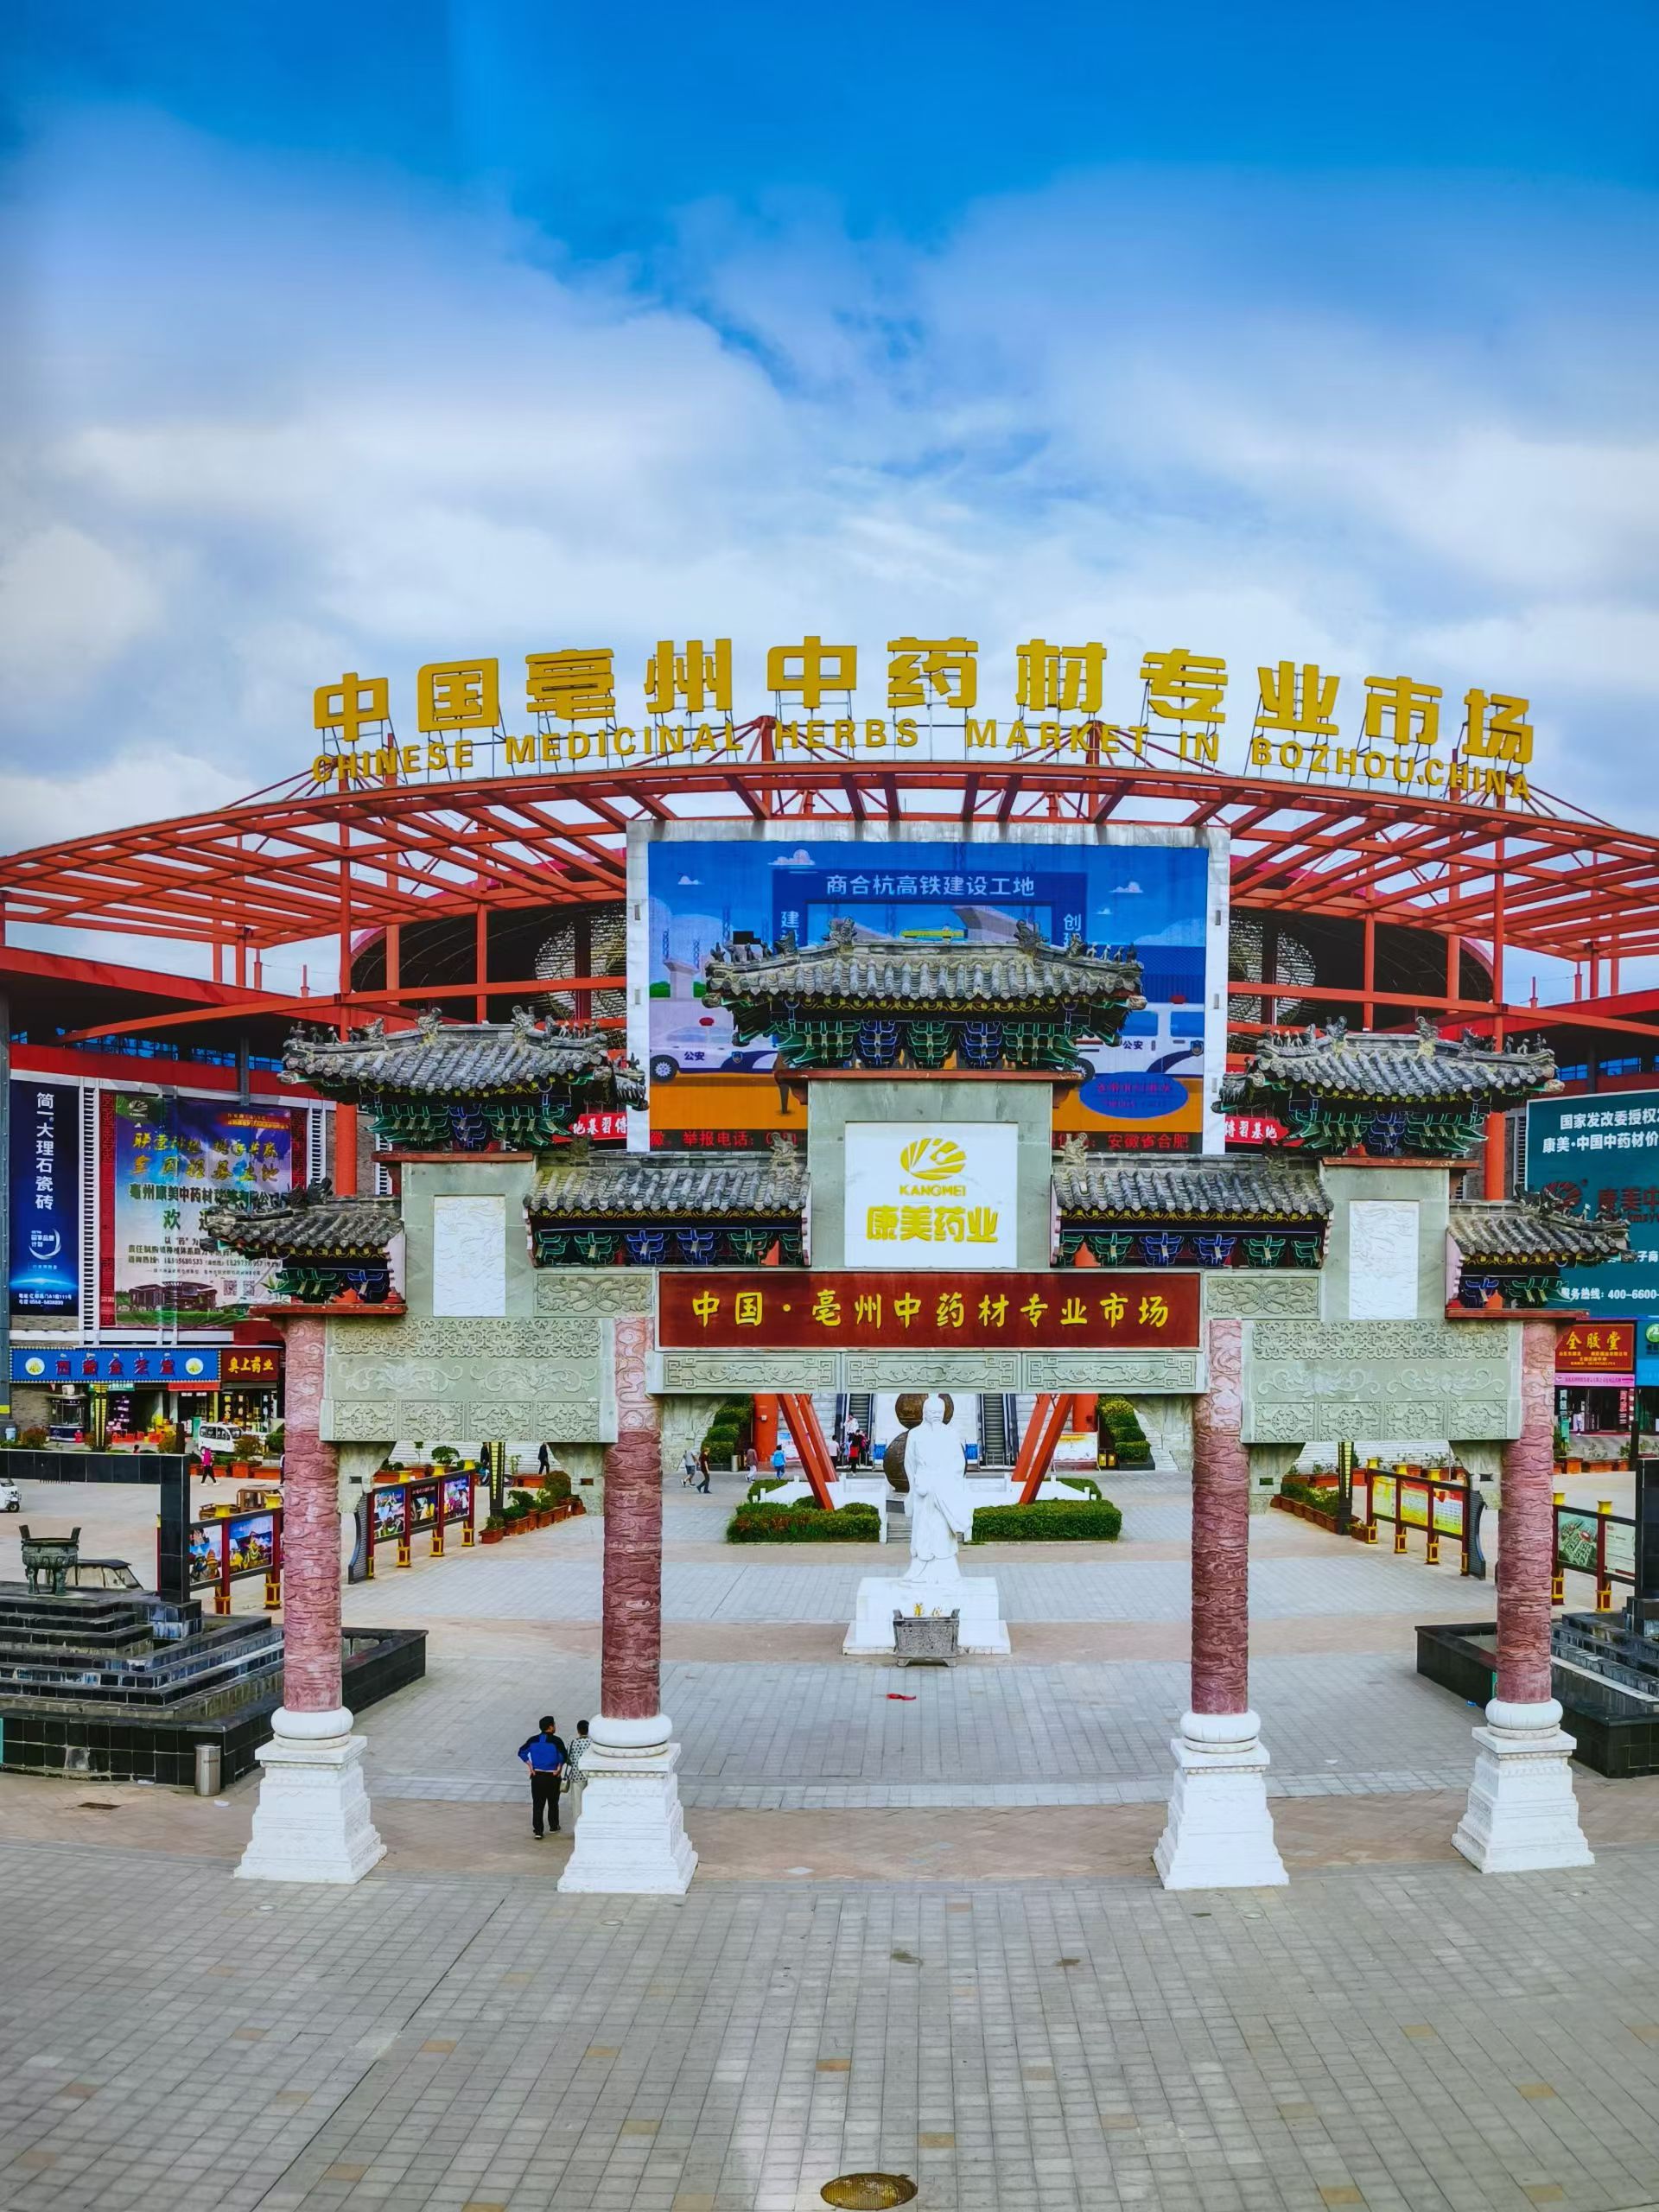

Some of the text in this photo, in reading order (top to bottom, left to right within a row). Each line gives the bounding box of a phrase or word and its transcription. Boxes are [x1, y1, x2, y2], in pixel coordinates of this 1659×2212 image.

[314, 636, 1535, 765] 中国亳州中药材专业市场
[313, 740, 474, 783] CHINESE
[505, 723, 744, 765] MEDICINAL
[777, 719, 918, 748] HERBS
[967, 719, 1150, 754] MARKET
[1179, 730, 1219, 762] IN
[826, 874, 1035, 897] 商合杭高铁建设工地
[683, 1051, 705, 1062] 公安
[1123, 1039, 1144, 1051] 公安
[1560, 1108, 1659, 1130] 国家发改委授权
[899, 1185, 967, 1197] KANGMEI
[866, 1205, 999, 1243] 康美药业
[692, 1289, 1170, 1329] 中国·亳州中药材专业市场
